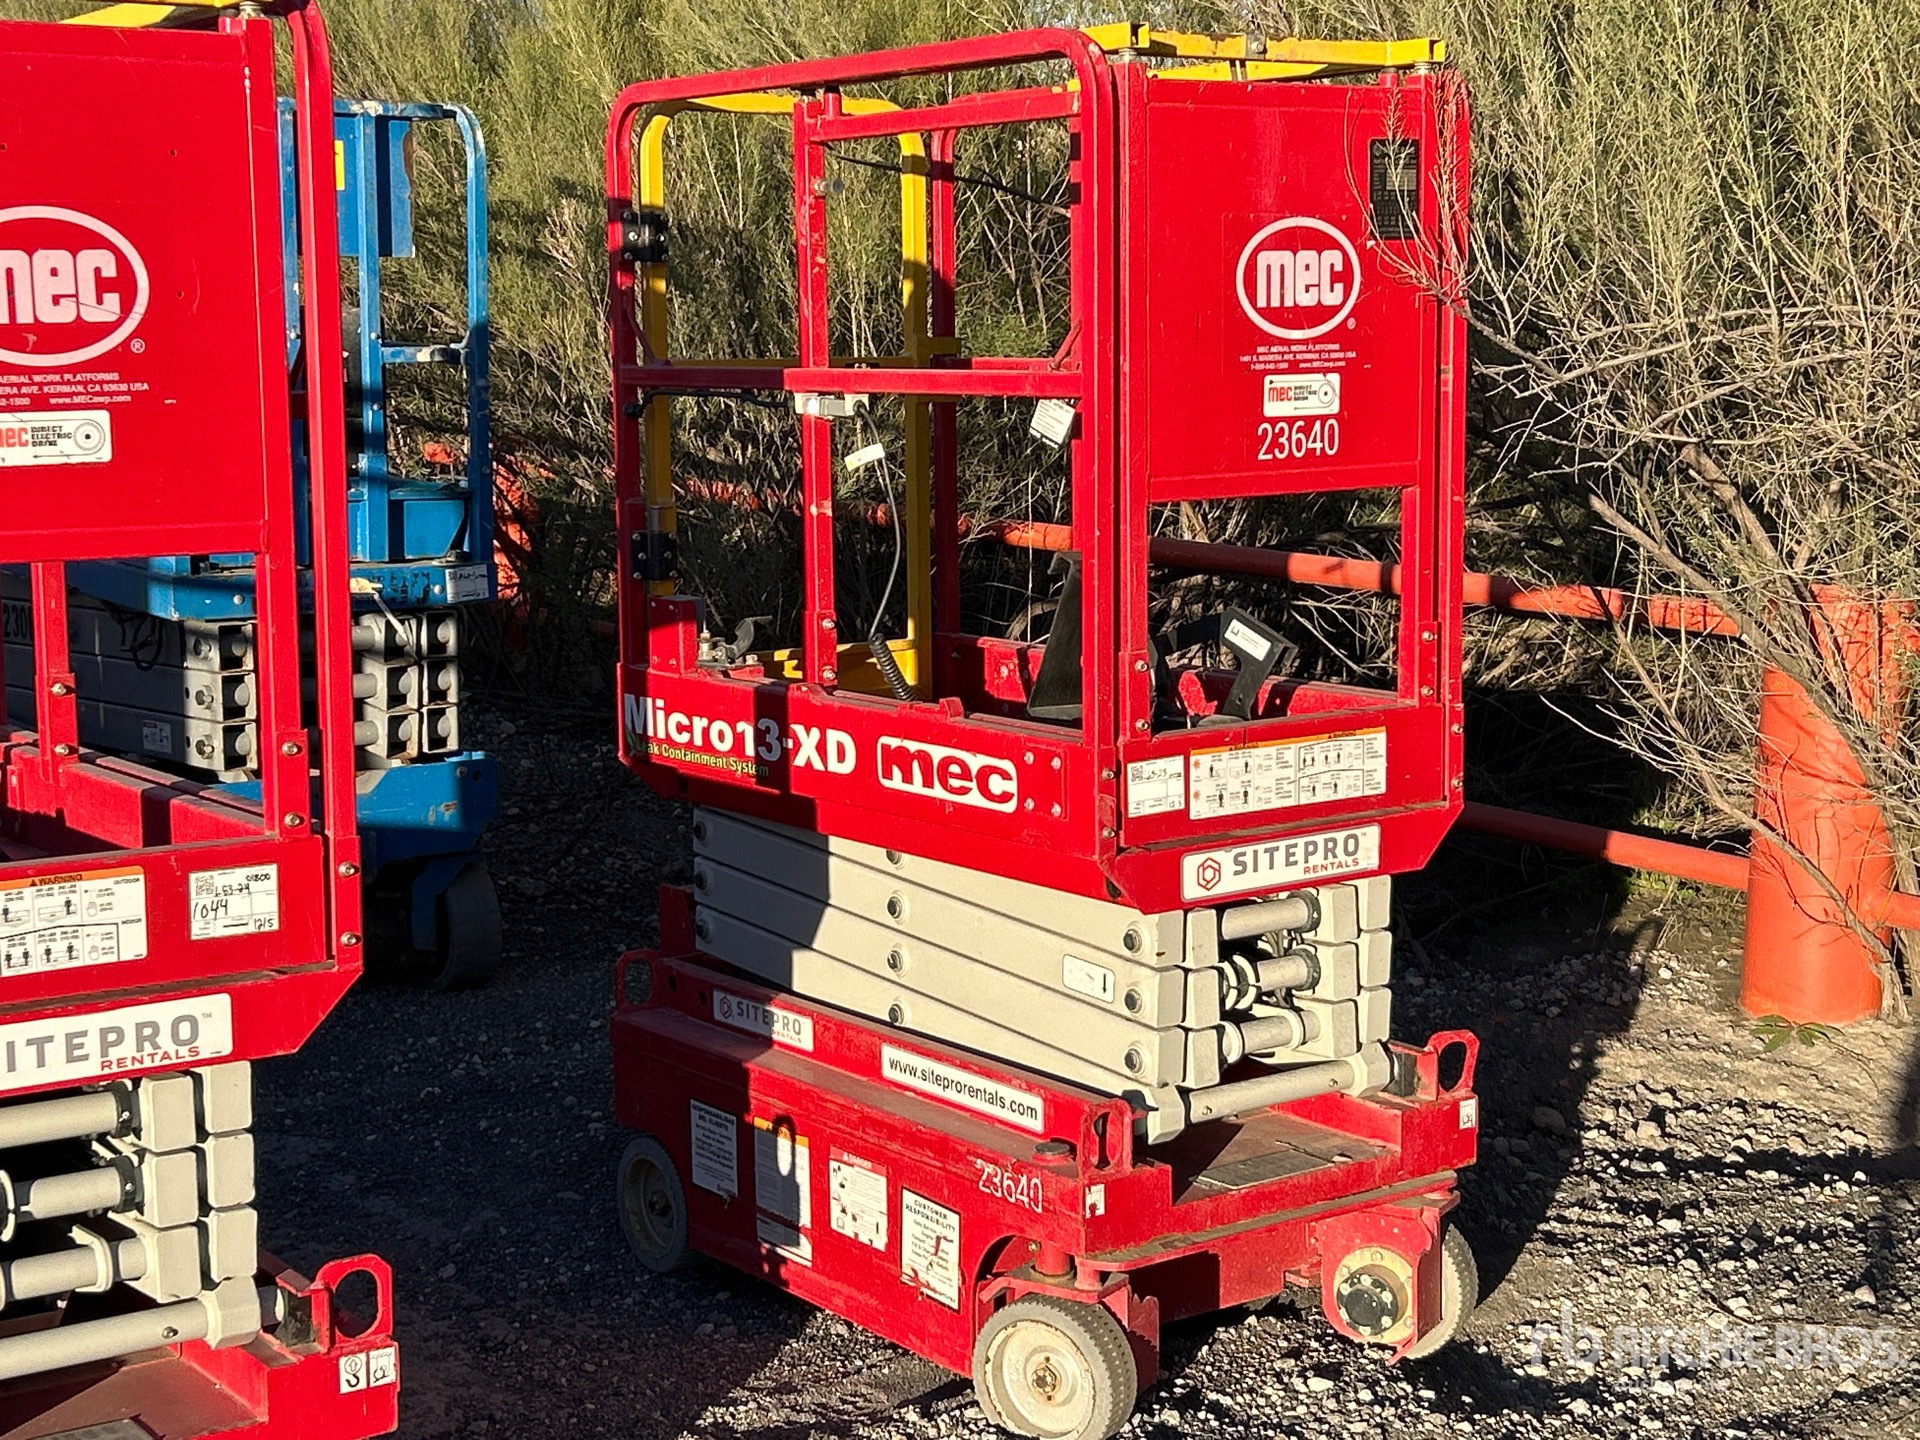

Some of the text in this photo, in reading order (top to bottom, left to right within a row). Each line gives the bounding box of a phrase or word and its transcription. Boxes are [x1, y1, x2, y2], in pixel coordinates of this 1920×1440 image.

[1257, 249, 1344, 308] mec
[32, 373, 62, 383] WORK
[63, 372, 120, 382] PLATFORMS
[87, 383, 101, 393] CA
[129, 382, 150, 391] USA
[1268, 386, 1293, 403] mec
[0, 427, 29, 449] ec
[30, 425, 63, 433] DIRECT
[31, 432, 73, 440] ELECTRIC
[1257, 419, 1339, 460] 23640
[624, 693, 857, 775] Micro13-XD
[661, 744, 728, 769] Containment
[729, 757, 770, 777] System
[880, 742, 1015, 804] mec
[1233, 833, 1360, 876] SITEPRO
[1303, 858, 1360, 875] RENTALS
[39, 874, 83, 886] WARNING
[737, 1000, 802, 1036] SITEPRO
[6, 1013, 200, 1074] ITEPRO
[100, 1046, 201, 1072] RENTALS
[888, 1056, 1038, 1121] www.siteprorentals.com
[974, 1158, 1043, 1213] 23640
